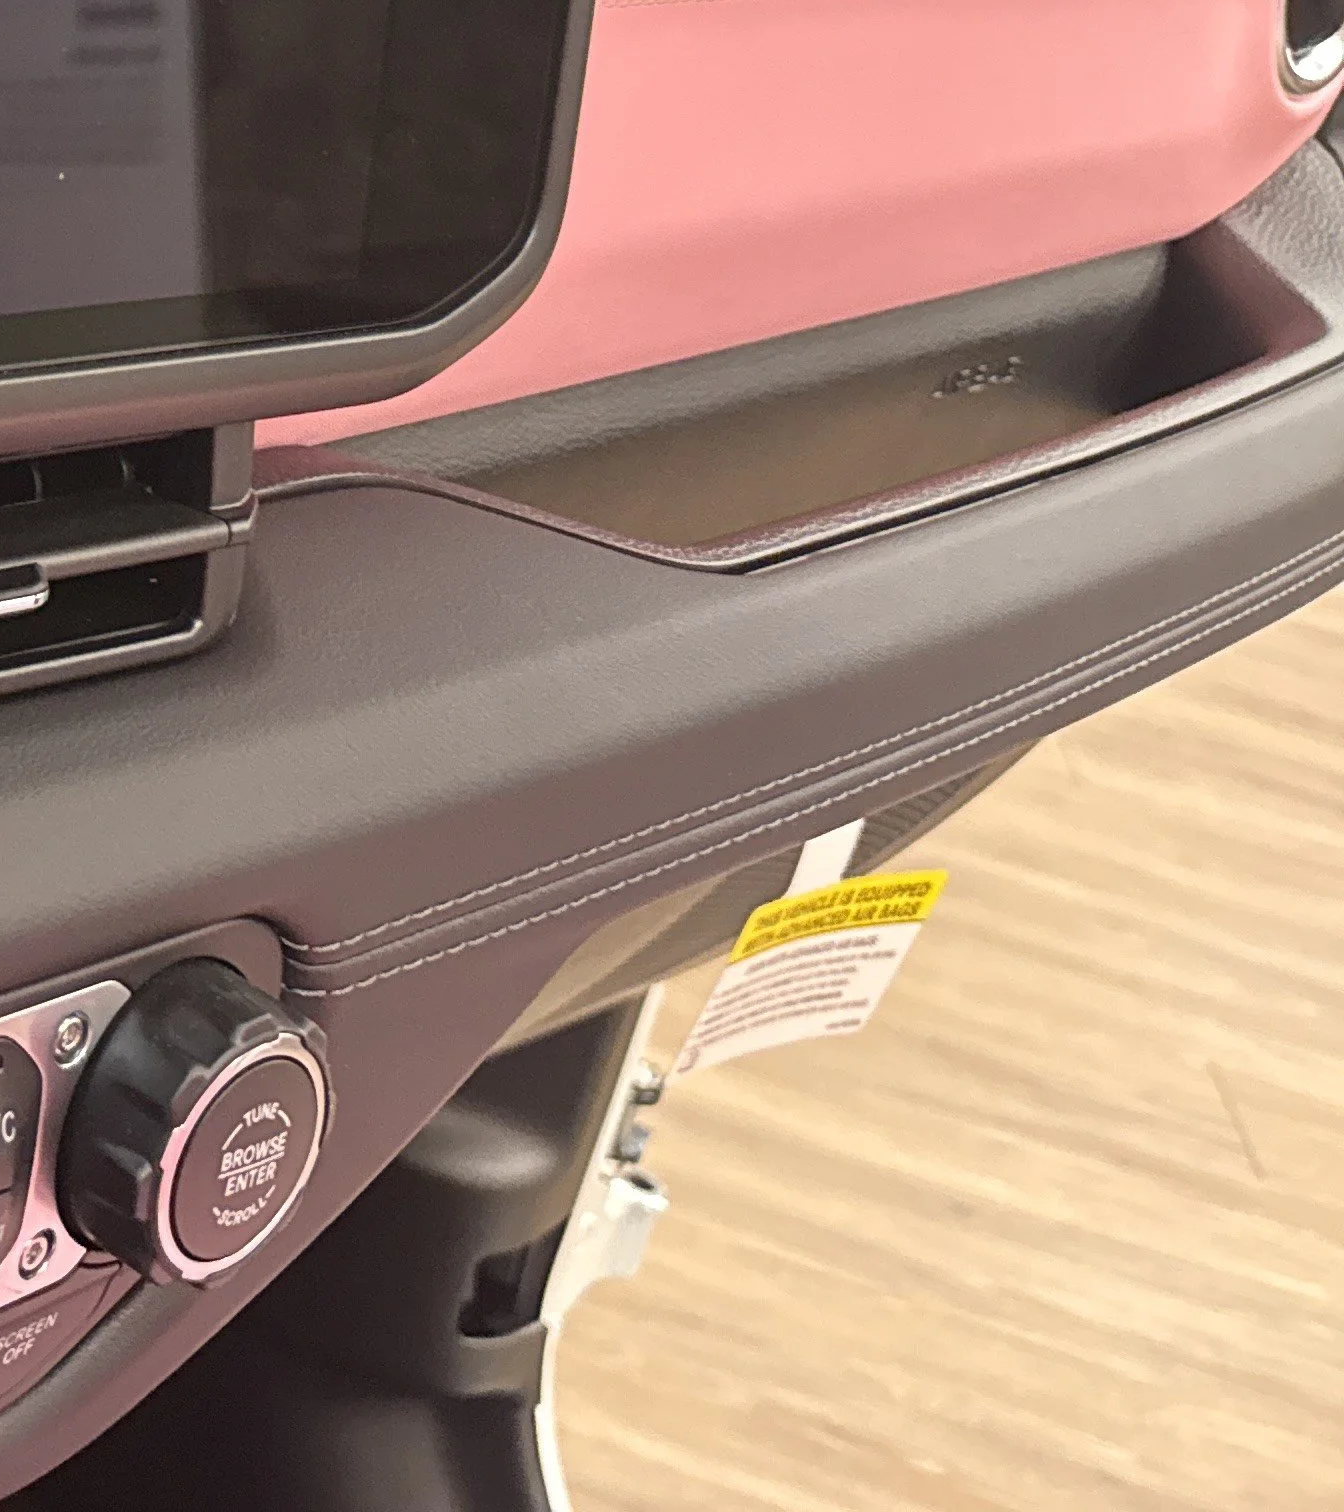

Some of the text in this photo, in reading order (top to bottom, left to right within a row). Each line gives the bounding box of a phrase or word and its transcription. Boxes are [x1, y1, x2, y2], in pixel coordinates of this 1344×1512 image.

[242, 1101, 280, 1127] TUNE
[220, 1130, 288, 1173] BROWSE
[224, 1161, 277, 1197] ENTER
[217, 1197, 268, 1226] SCROLL
[2, 1337, 36, 1365] OFF
